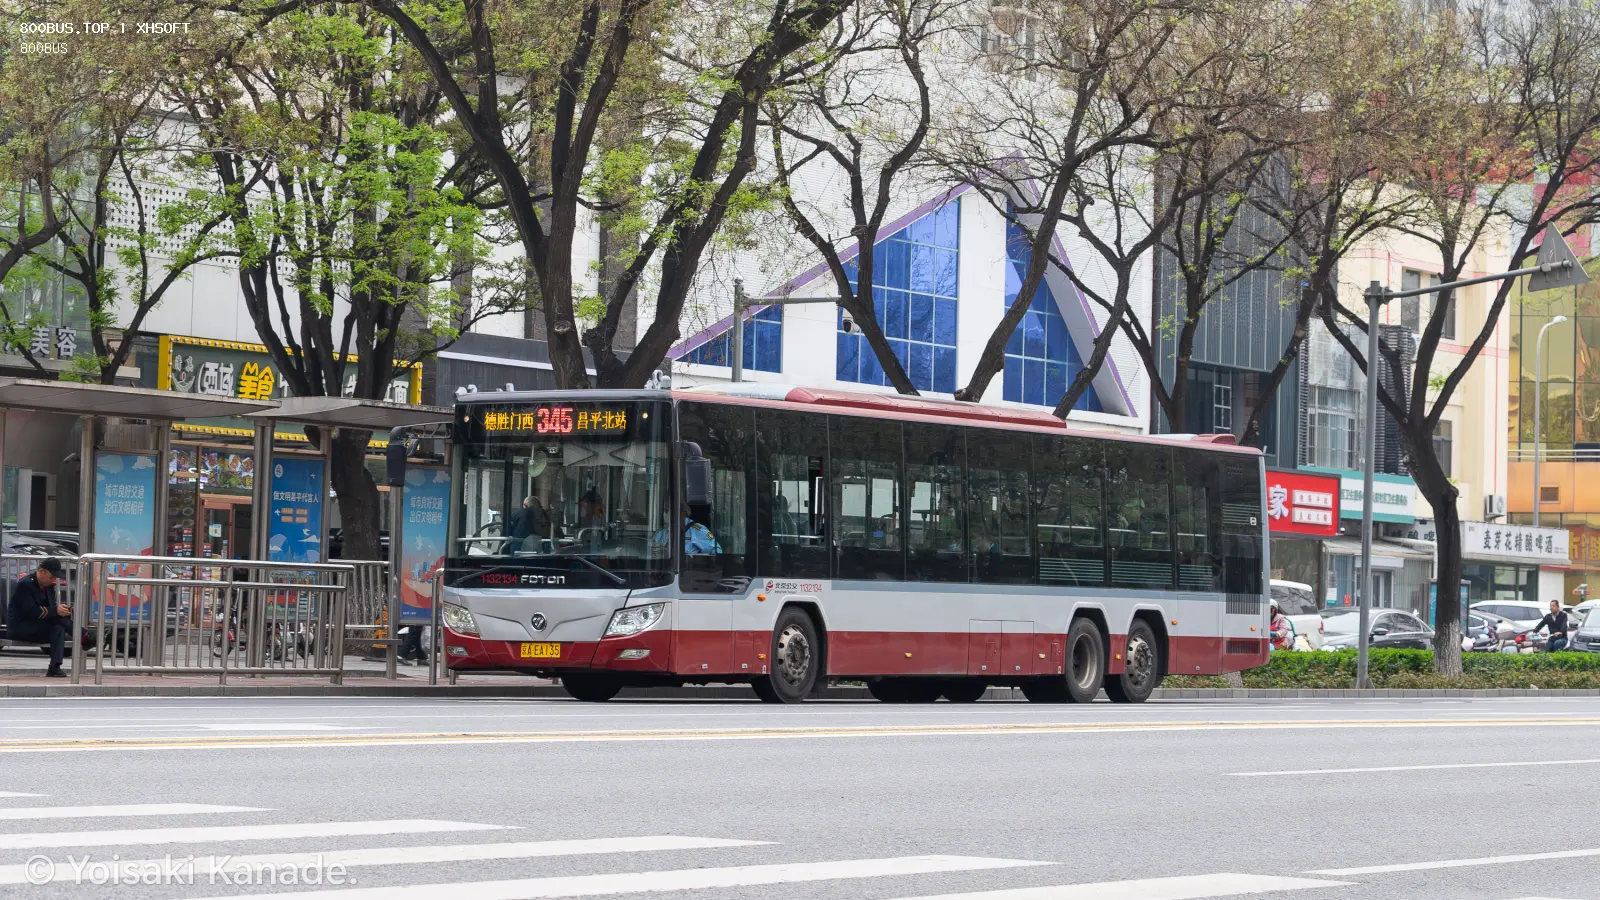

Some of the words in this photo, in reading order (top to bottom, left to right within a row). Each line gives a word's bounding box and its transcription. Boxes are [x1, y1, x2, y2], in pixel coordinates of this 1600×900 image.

[485, 411, 533, 431] 德胜门西
[537, 407, 573, 433] 345
[577, 411, 627, 430] 昌平北站
[104, 484, 144, 499] 城市良好交通
[104, 500, 144, 515] 出行文明相伴
[1483, 528, 1553, 554] 麦芽花精酿啤酒
[481, 574, 518, 584] 1132134
[800, 584, 822, 592] 1132134
